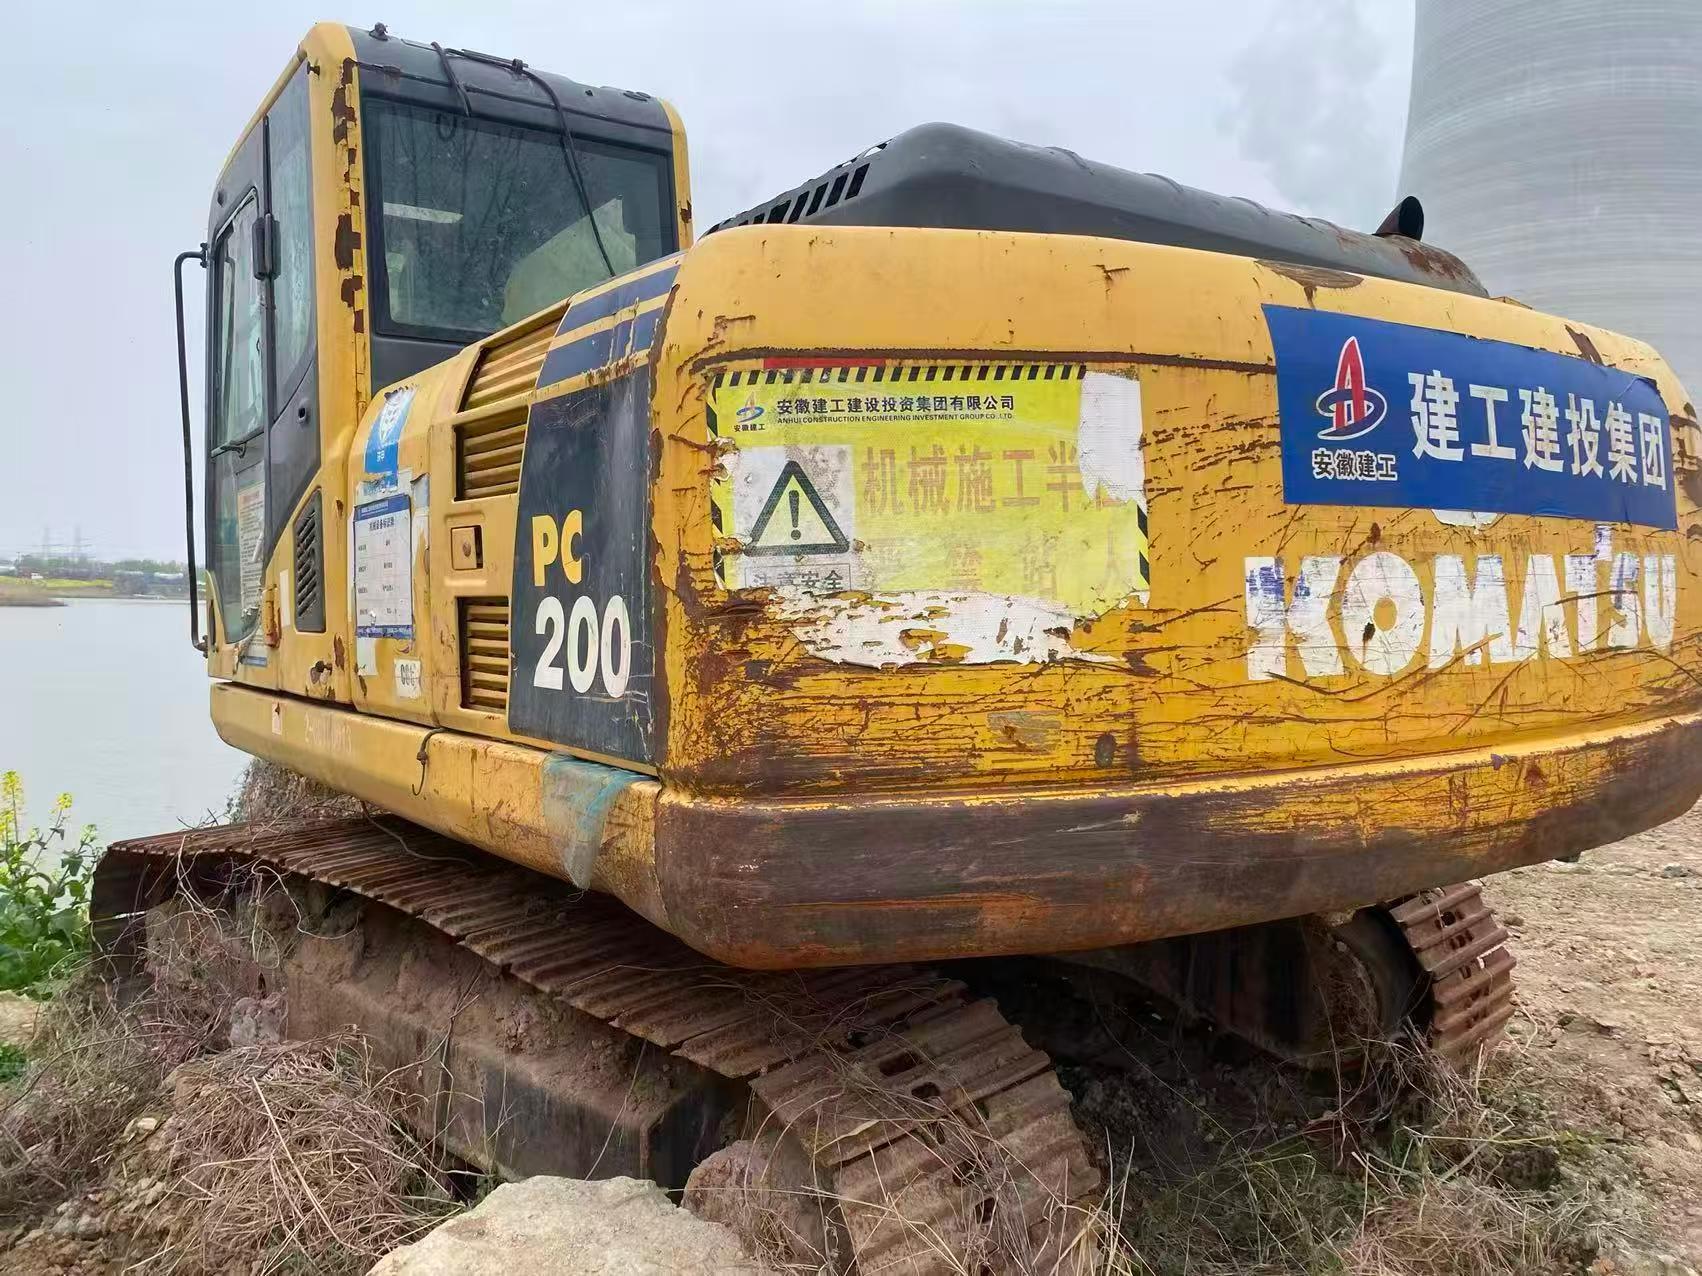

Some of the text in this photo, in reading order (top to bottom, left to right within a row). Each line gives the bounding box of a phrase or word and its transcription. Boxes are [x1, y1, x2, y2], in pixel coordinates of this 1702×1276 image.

[734, 423, 765, 432] 安徽建工
[777, 395, 1014, 414] 安徽建工建设投资集团有限公司
[802, 415, 861, 423] CONSTRUCTION
[1407, 369, 1667, 491] 建工建投集团
[862, 440, 1126, 515] 机械施工半
[1312, 448, 1397, 481] 安徽建工
[532, 509, 583, 587] PC
[533, 594, 632, 699] 200
[1244, 551, 1677, 681] KOMATSU
